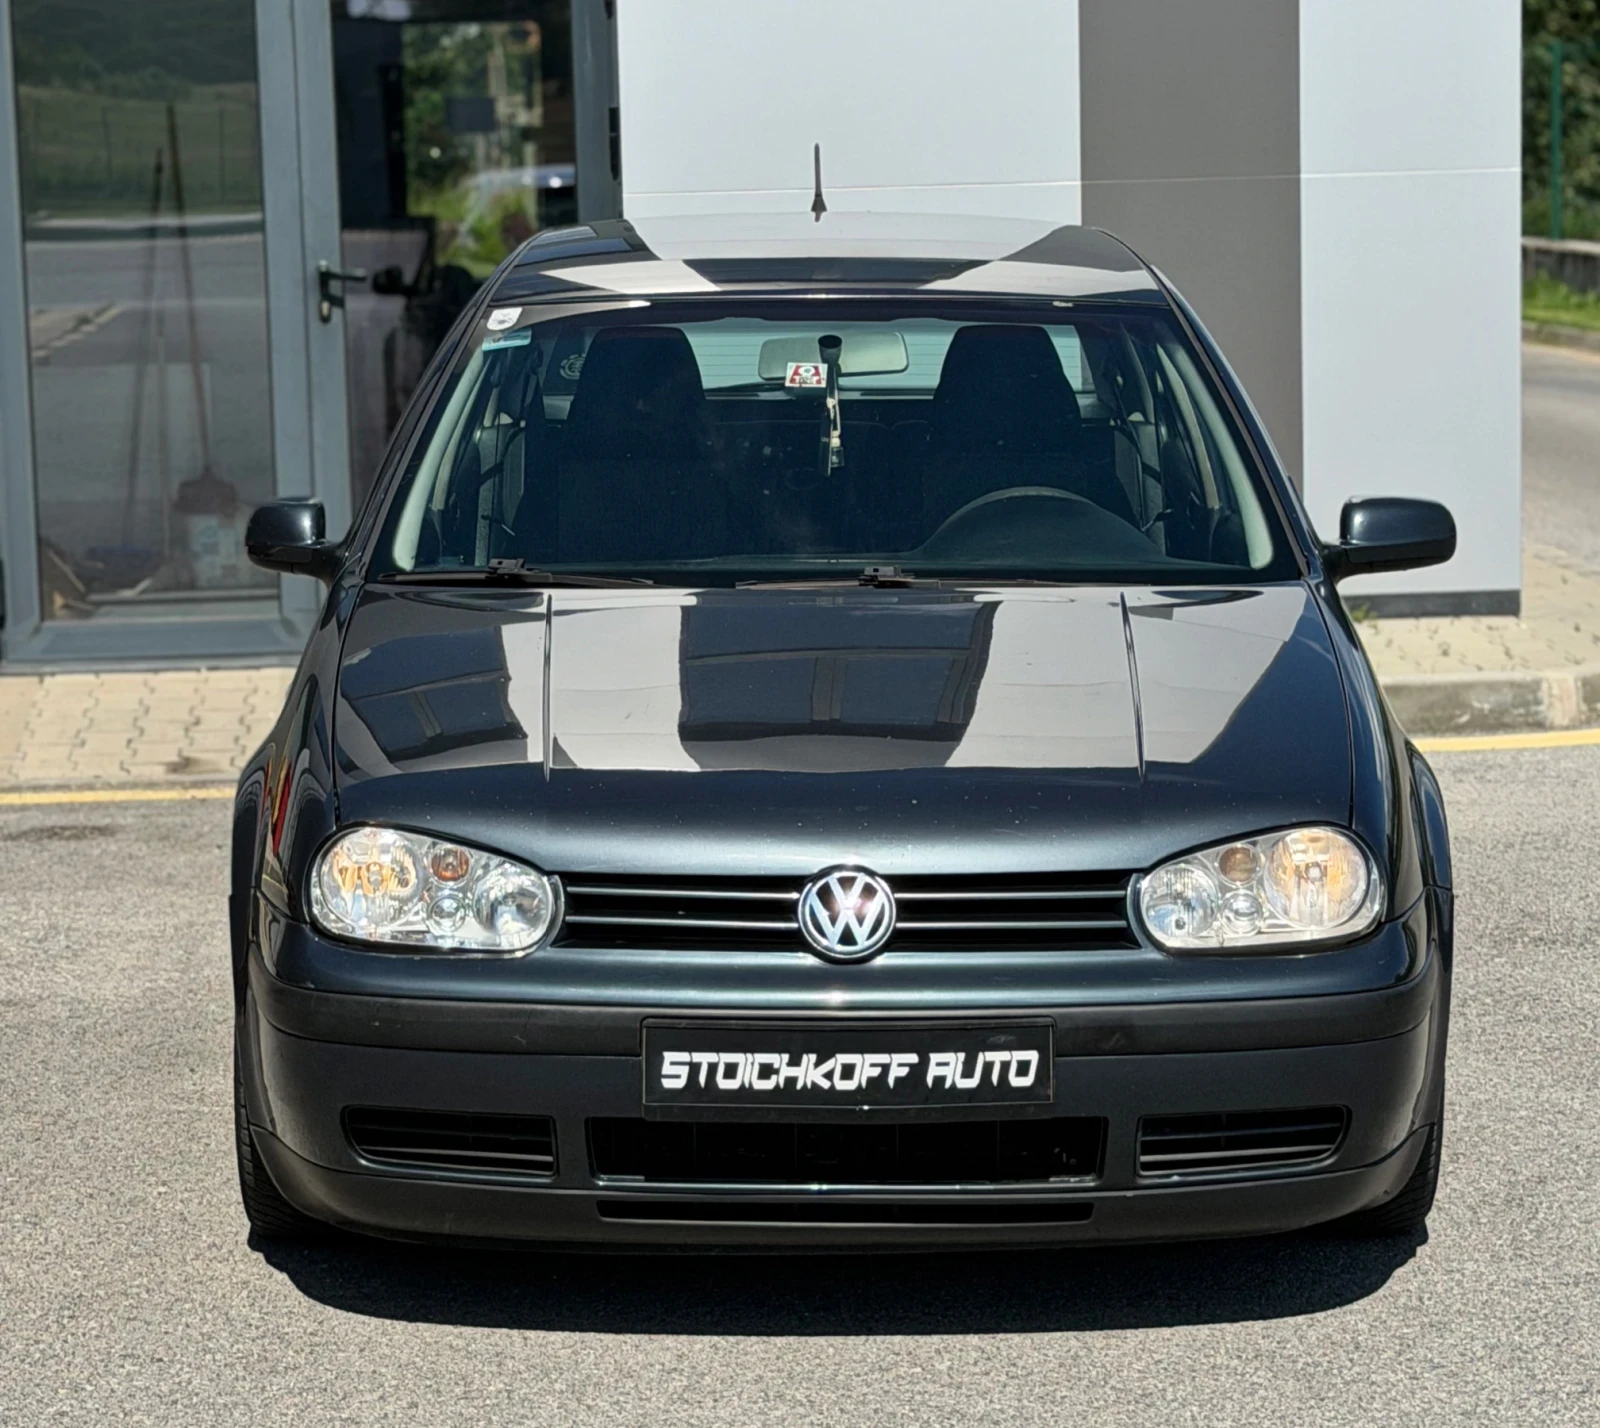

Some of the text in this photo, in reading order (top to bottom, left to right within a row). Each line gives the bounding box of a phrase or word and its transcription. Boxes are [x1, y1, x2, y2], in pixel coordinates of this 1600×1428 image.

[806, 871, 888, 951] VW
[660, 1049, 1040, 1091] STOICHKOFF AUTO
